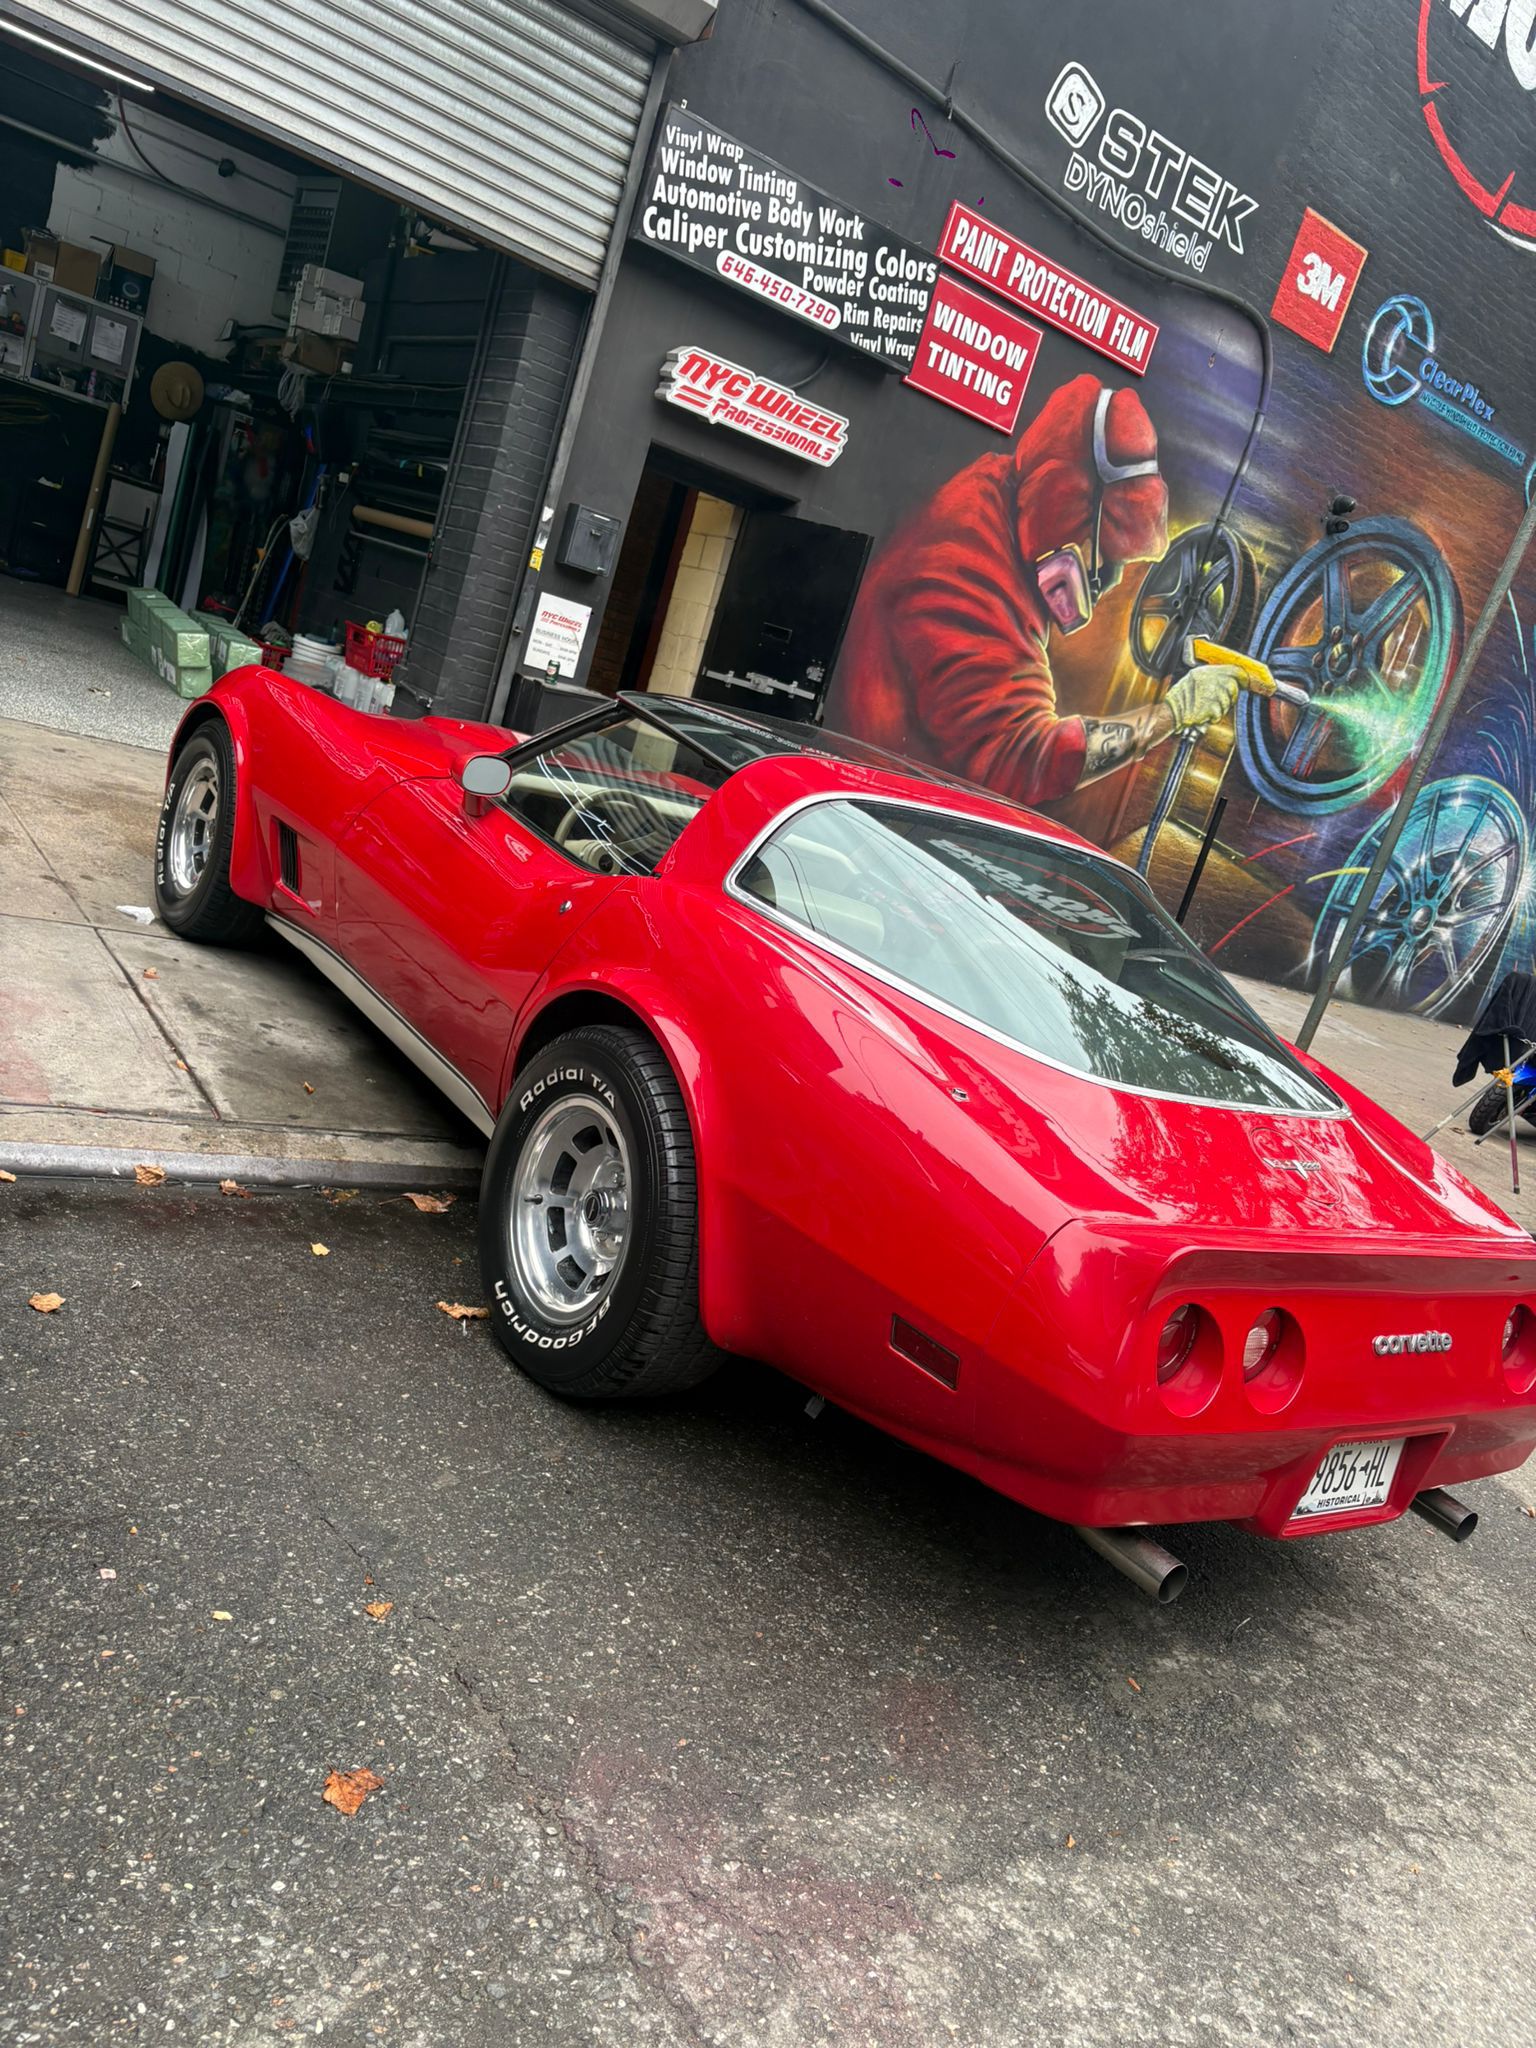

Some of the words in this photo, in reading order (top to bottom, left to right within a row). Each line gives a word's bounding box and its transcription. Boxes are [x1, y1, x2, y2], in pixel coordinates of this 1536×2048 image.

[661, 146, 733, 186] Window
[738, 163, 797, 204] Tinting
[666, 124, 702, 154] Vinyl
[707, 133, 744, 163] Wrap
[652, 174, 762, 221] Automotive
[767, 196, 814, 237] Body
[818, 206, 865, 241] Work
[1064, 152, 1213, 273] DYNOshield
[1098, 108, 1260, 255] STEK
[642, 205, 728, 253] Caliper
[735, 222, 868, 280] Customizing
[875, 246, 938, 284] Colors
[721, 254, 837, 326] 646-450-7290
[802, 266, 865, 298] Powder
[868, 276, 929, 312] Coating
[950, 217, 1009, 279] PAINT
[1007, 252, 1112, 340] PROTECTION
[1108, 312, 1150, 363] FILM
[1296, 252, 1347, 313] 3M
[842, 301, 870, 326] Rim
[873, 306, 924, 336] Repairs
[850, 332, 882, 354] Vinyl
[885, 336, 917, 362] Wrap
[932, 301, 1029, 373] WINDOW
[678, 352, 751, 398] NYC
[745, 383, 844, 443] WHEEL
[927, 341, 1013, 407] TINTING
[1418, 357, 1496, 421] ClearPlex
[711, 397, 836, 462] PROFESSIONALS
[157, 819, 167, 885] Radial
[519, 1065, 585, 1113] Radial
[590, 1072, 616, 1109] T/A
[1372, 1329, 1453, 1355] corvette
[1316, 1494, 1361, 1509] HISTORICAL
